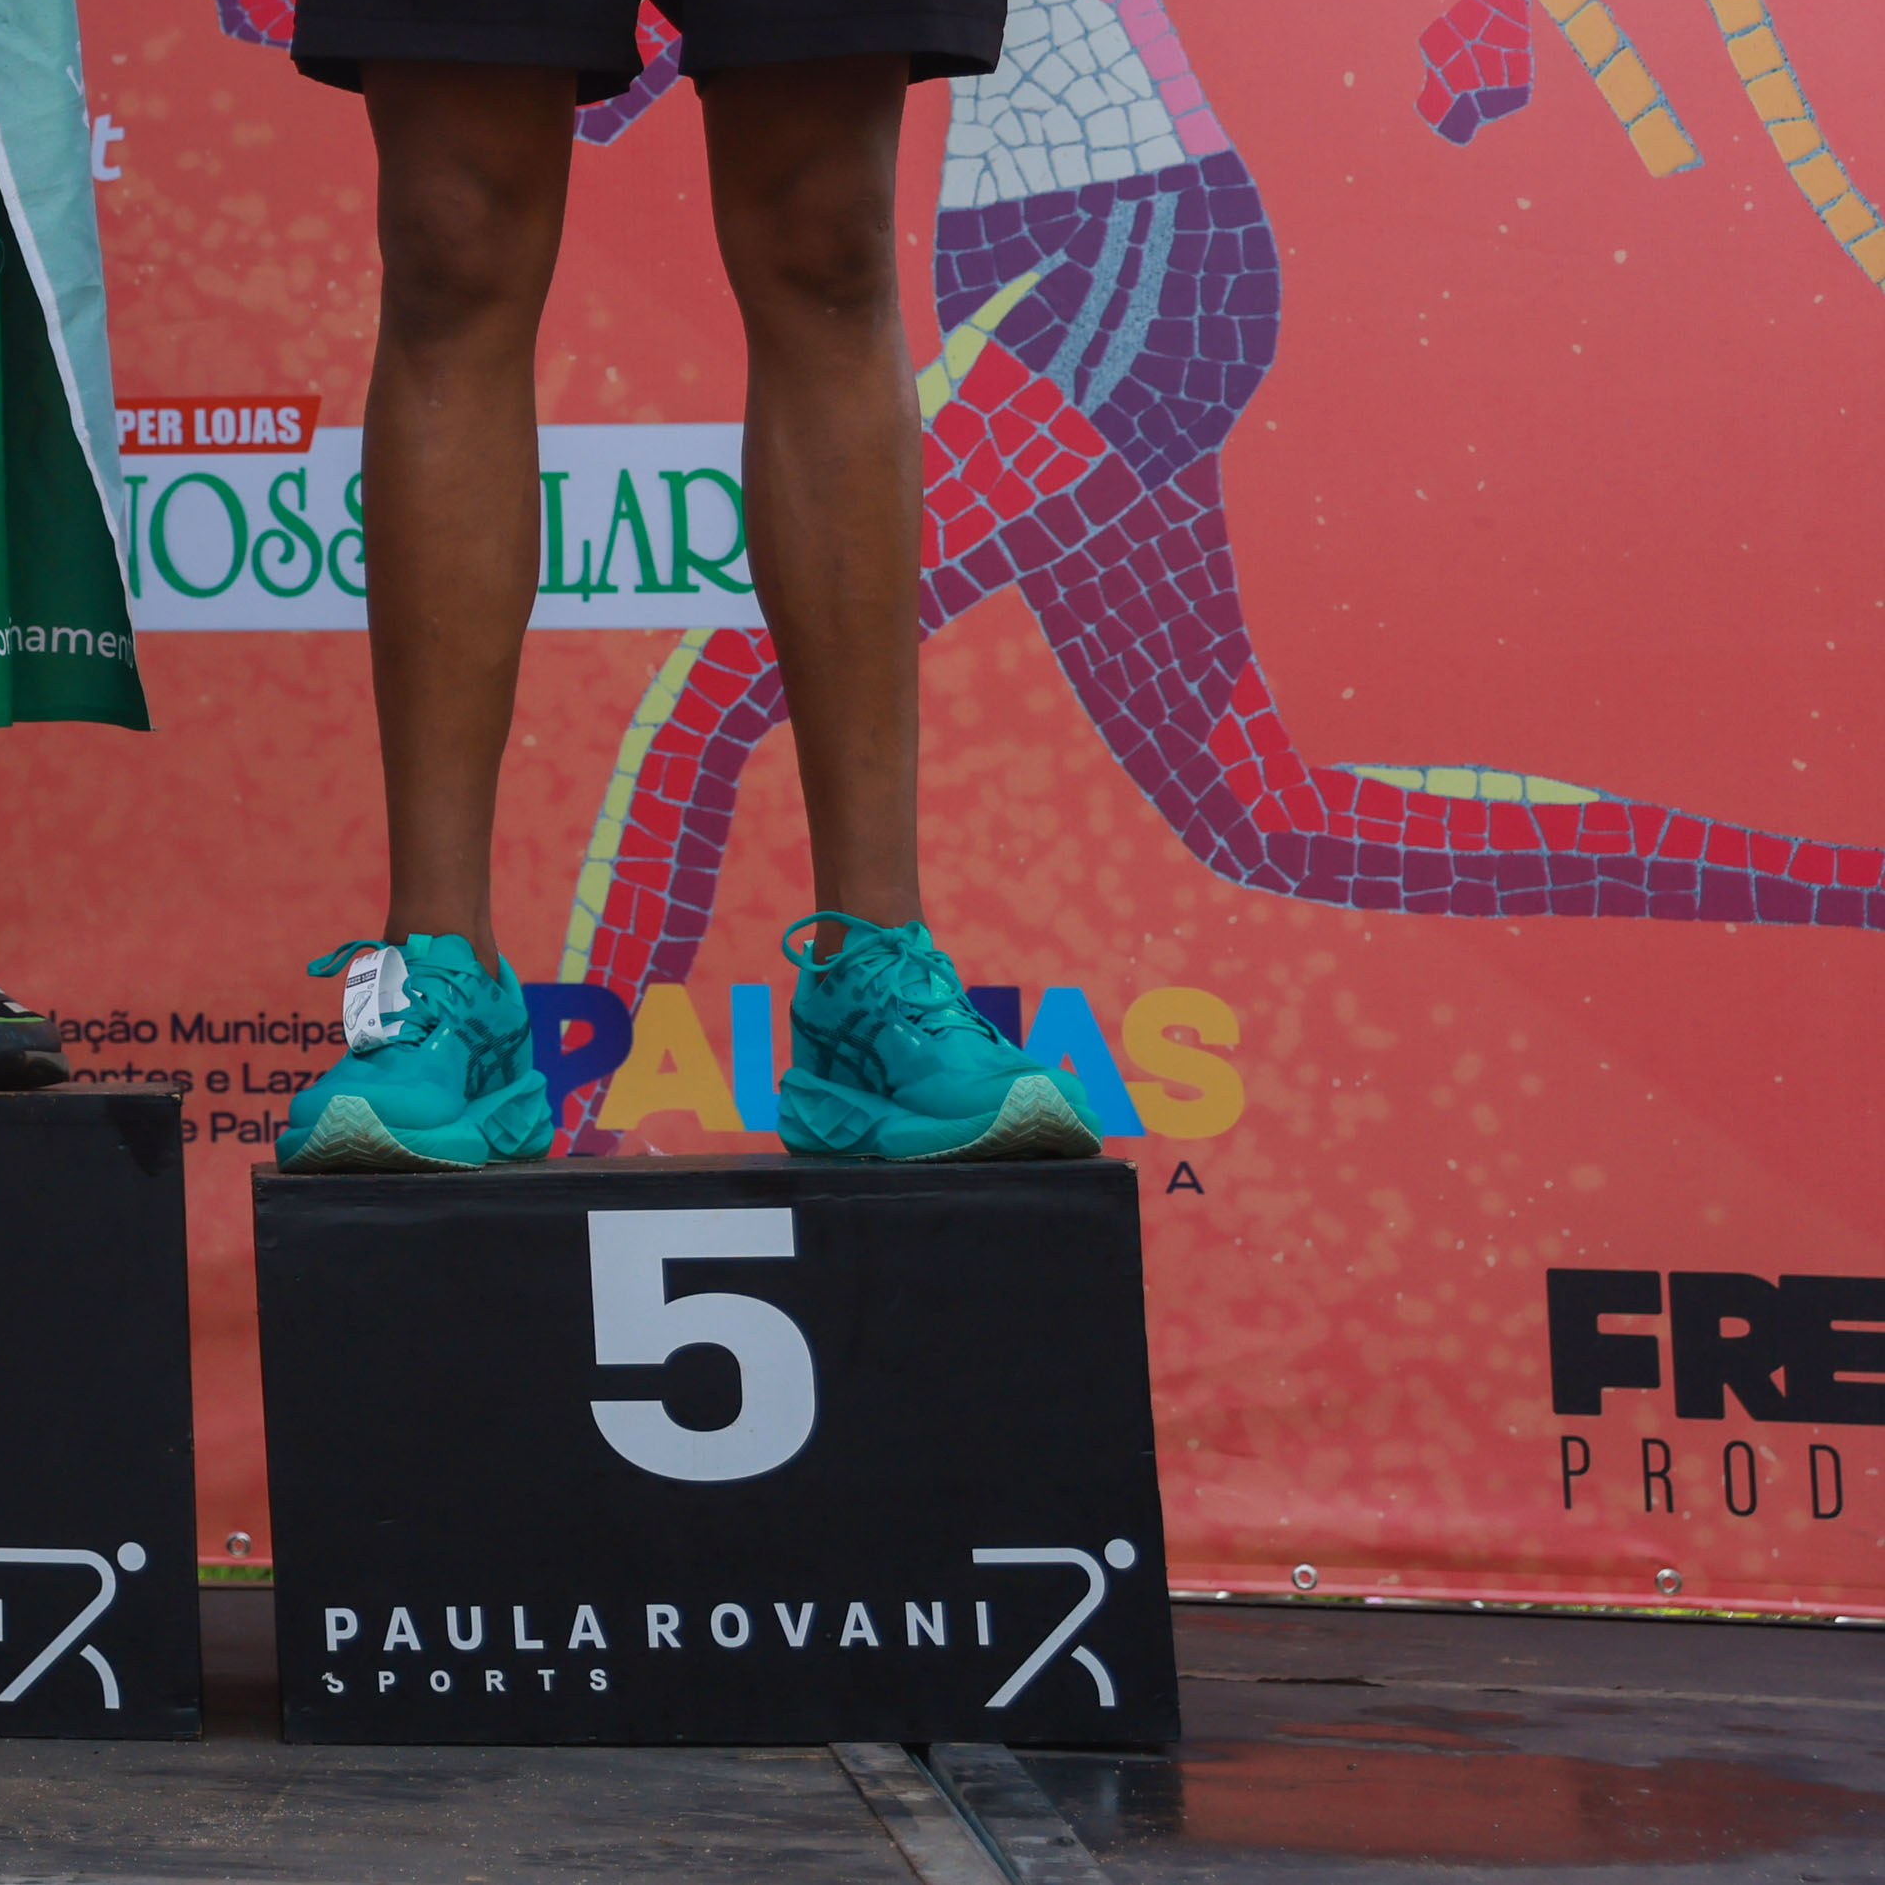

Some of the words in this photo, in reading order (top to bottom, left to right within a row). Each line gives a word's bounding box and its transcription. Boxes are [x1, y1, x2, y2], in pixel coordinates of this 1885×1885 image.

[192, 405, 302, 446] LOJAS
[50, 1007, 158, 1054] ação
[171, 1012, 347, 1053] Municipa
[69, 1064, 195, 1094] ortes
[206, 1068, 230, 1094] e
[524, 982, 1245, 1140] PALAS
[586, 1208, 818, 1483] 5
[1561, 1434, 1844, 1520] PROD
[325, 1603, 606, 1655] PAULA
[647, 1600, 993, 1651] ROVANI
[325, 1666, 613, 1697] SPORTS
